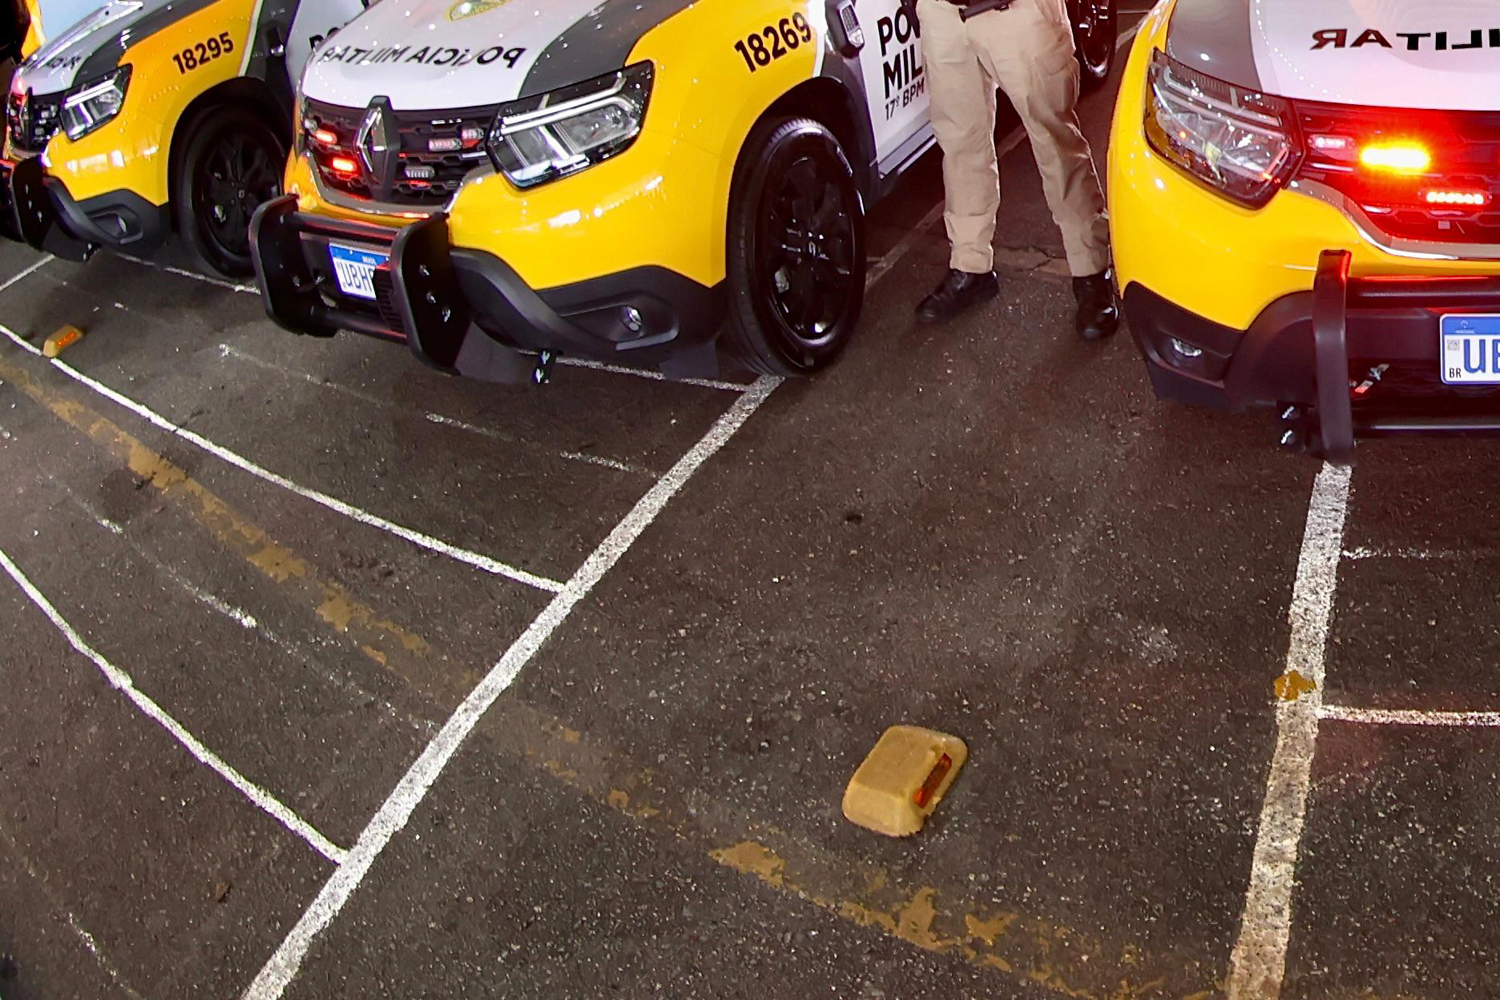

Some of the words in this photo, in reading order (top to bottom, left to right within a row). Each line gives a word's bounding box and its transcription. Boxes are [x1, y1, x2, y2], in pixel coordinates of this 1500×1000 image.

[173, 31, 234, 75] 18295
[734, 12, 811, 73] 18269
[883, 44, 923, 100] MIL
[902, 78, 924, 107] BPM
[1449, 367, 1462, 378] BR
